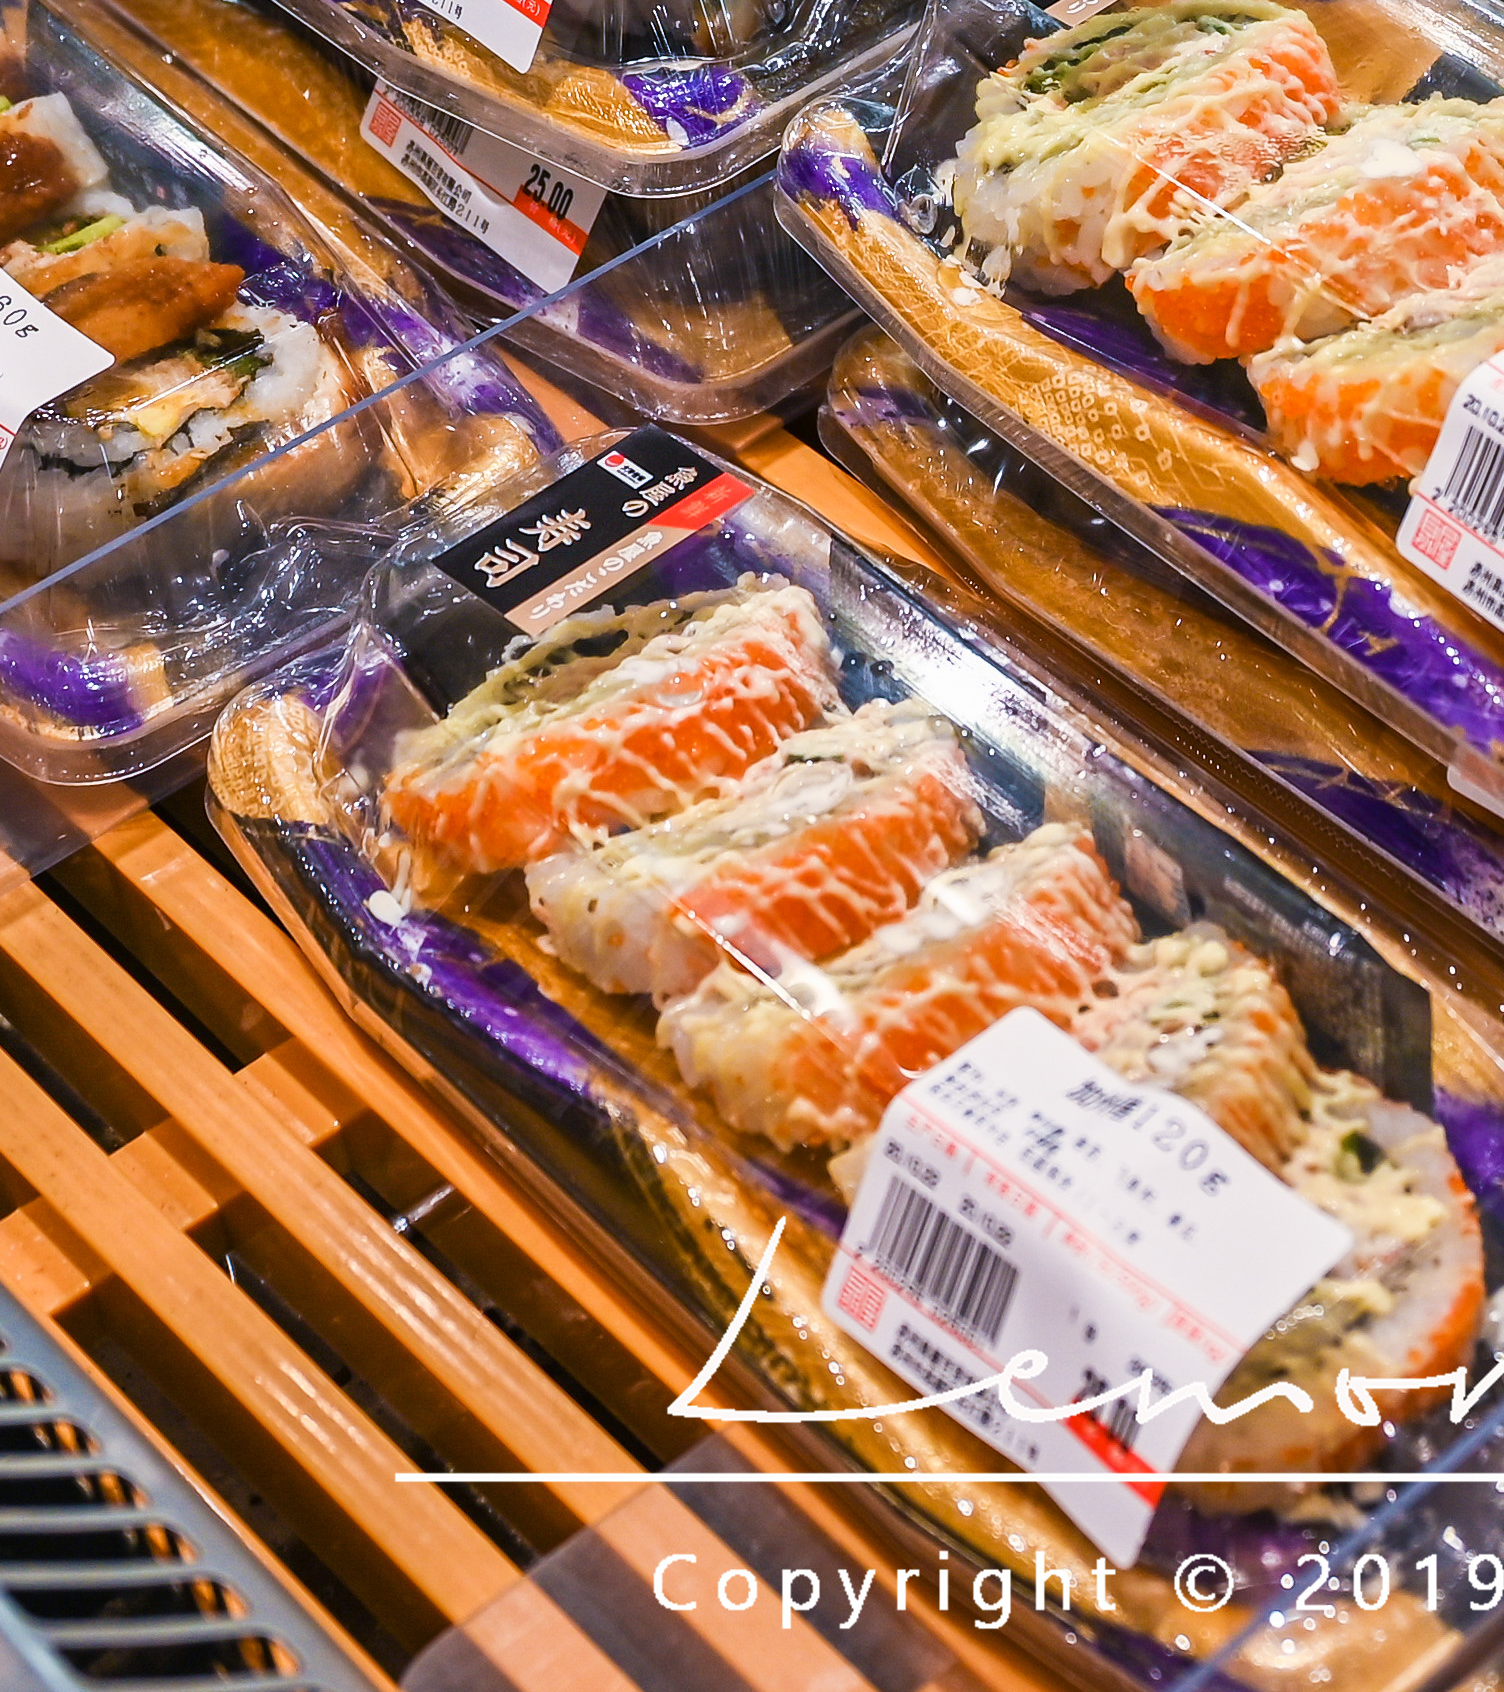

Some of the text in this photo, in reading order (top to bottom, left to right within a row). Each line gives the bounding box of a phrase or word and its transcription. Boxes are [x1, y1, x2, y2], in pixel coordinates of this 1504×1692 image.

[523, 163, 574, 221] 25.00
[622, 466, 698, 518] 魚屋の
[680, 484, 732, 517] 新鮮
[474, 508, 592, 588] 寿司
[530, 531, 664, 620] 魚屋のこだわり
